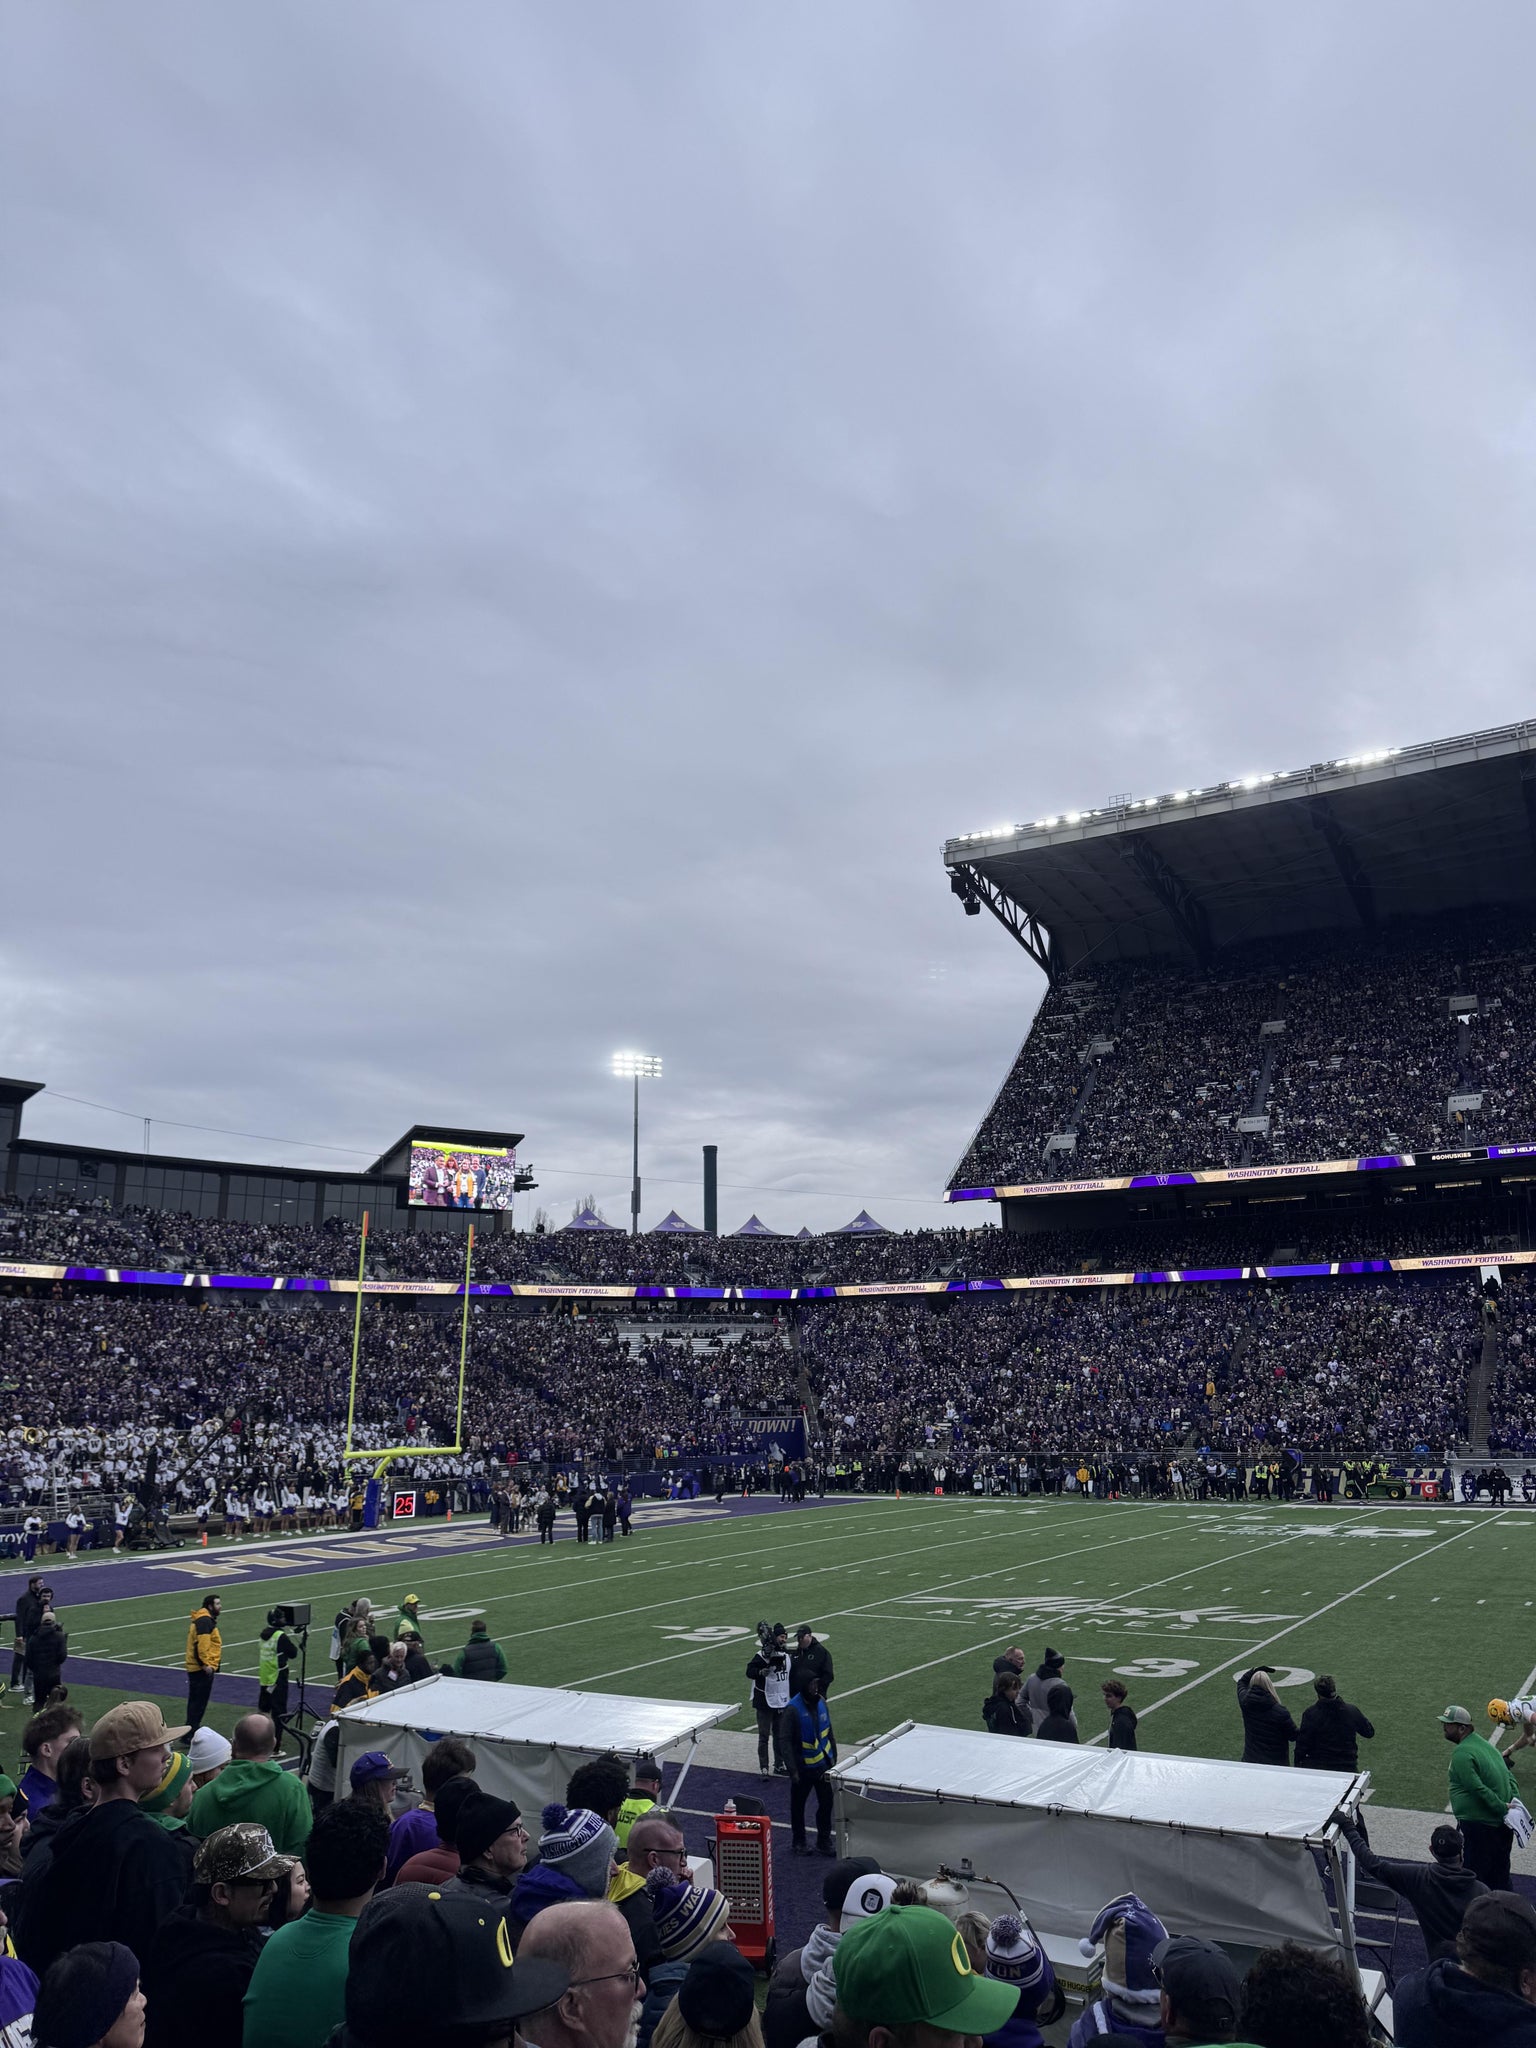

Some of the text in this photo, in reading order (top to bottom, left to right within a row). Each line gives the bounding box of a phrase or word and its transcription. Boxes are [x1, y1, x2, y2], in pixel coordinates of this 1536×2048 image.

[1432, 1152, 1472, 1160] #GOHUSKIES
[1498, 1147, 1516, 1155] NEED
[1227, 1165, 1321, 1179] WASHINGTON FOOTBALL
[1156, 1175, 1170, 1186] W
[1023, 1182, 1105, 1194] WASHINGTON FOOTBALL
[1422, 1255, 1515, 1267] WASHINGTON FOOTBALL
[1029, 1276, 1105, 1287] WASHINGTON FOOTBALL
[401, 1284, 435, 1292] FOOTBALL
[537, 1286, 609, 1296] WASHINGTON FOOTBALL
[858, 1283, 927, 1294] WASHINGTON FOOTBALL
[395, 1496, 413, 1514] 25
[926, 1609, 1194, 1630] AIRLINES
